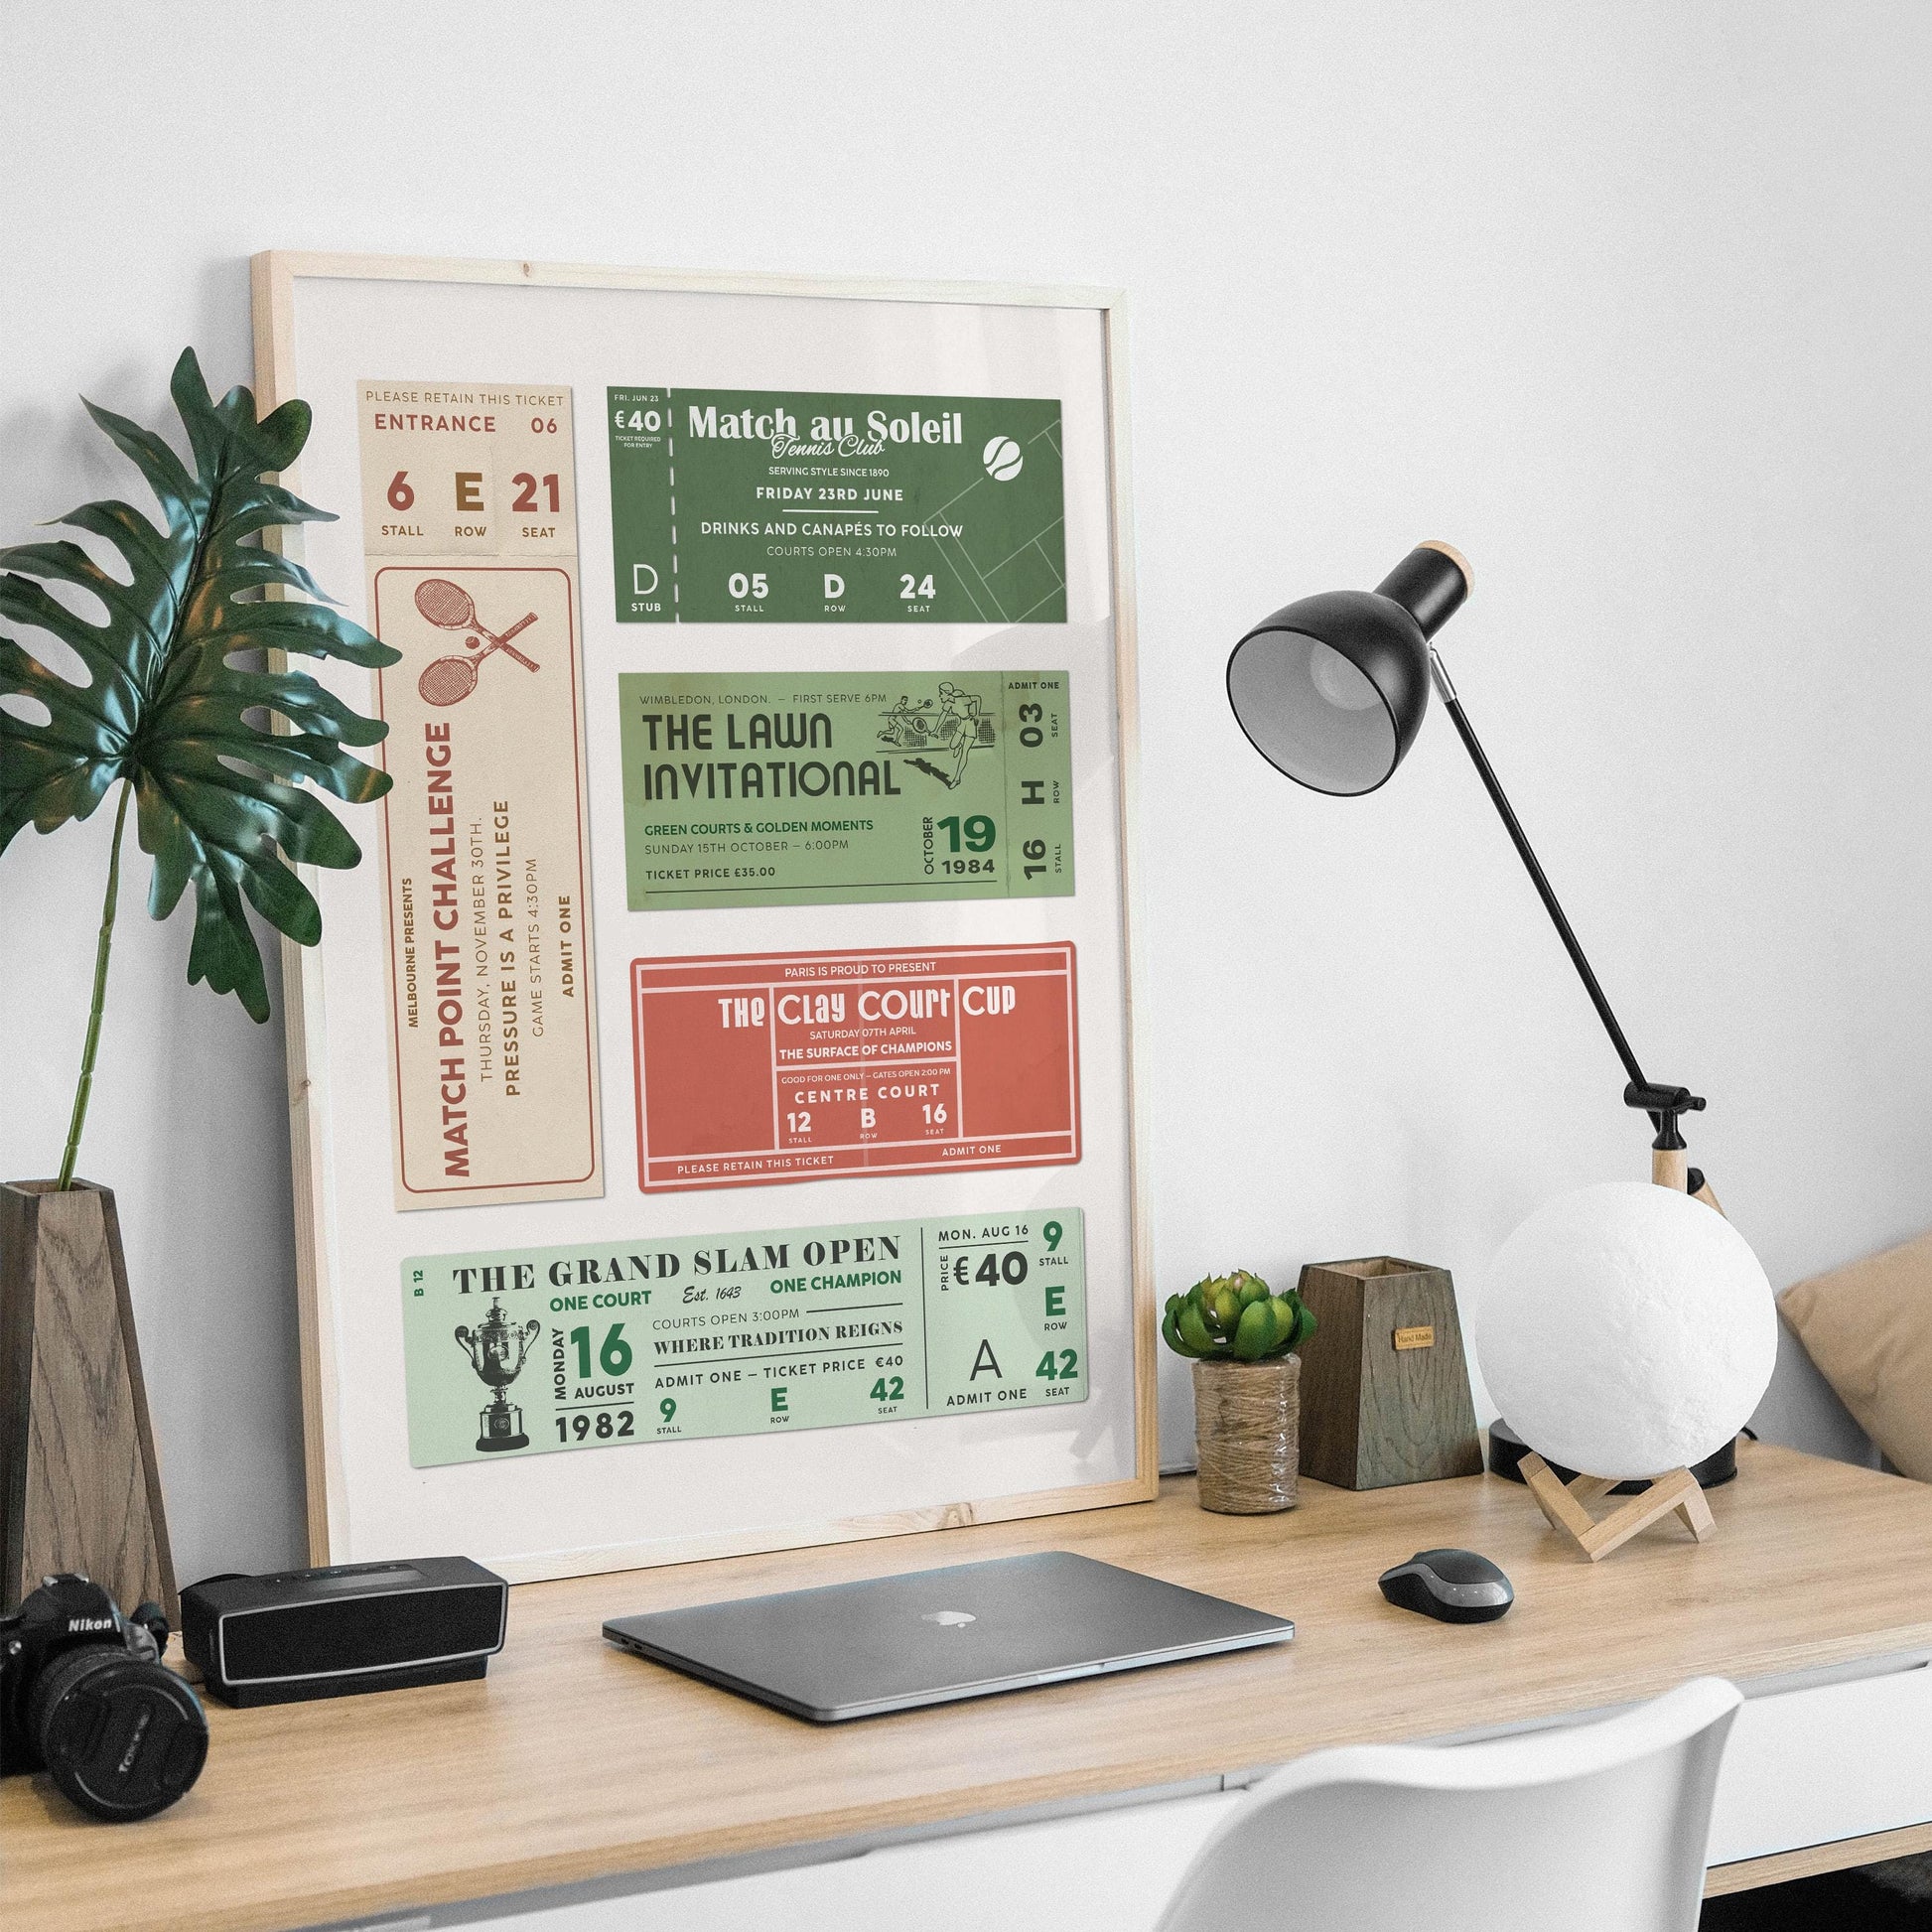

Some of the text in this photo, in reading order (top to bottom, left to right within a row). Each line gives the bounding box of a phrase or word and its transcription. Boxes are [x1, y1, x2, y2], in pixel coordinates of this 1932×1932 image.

[366, 390, 564, 406] PLEASE RETAIN THIS TICKET
[375, 413, 557, 434] ENTRANCE 06
[688, 405, 962, 444] Match au Soleil
[771, 432, 886, 460] Tennis Club
[768, 467, 890, 478] SERVING STYLE SINCE 1890
[387, 471, 415, 511] 6
[455, 472, 484, 511] E
[511, 473, 560, 512] 21
[757, 486, 903, 501] FRIDAY 23RD JUNE
[381, 525, 424, 536] STALL
[455, 526, 486, 537] ROW
[701, 521, 963, 538] DRINKS AND CANAPÉS TO FOLLOW
[766, 546, 897, 557] COURTS OPEN 4:30PM
[633, 564, 658, 595] D
[729, 573, 768, 599] 05
[824, 574, 845, 599] D
[899, 574, 936, 599] 24
[631, 603, 661, 612] STUB
[1008, 681, 1037, 690] ADMIT
[639, 694, 887, 705] WIMBLEDON, LONDON. FIRST SERVE 6PM
[642, 713, 832, 751] THE LAWN
[1019, 703, 1043, 748] 03
[643, 759, 901, 800] INVITATIONAL
[1021, 780, 1044, 804] H
[644, 820, 874, 836] GREEN COURTS GOLDEN MOMENTS
[936, 815, 996, 853] 19
[644, 840, 849, 855] SUNDAY 15TH OCTOBER 6:00PM
[922, 816, 934, 875] OCTOBER
[941, 859, 995, 875] 1984
[1023, 839, 1046, 881] 16
[645, 867, 775, 880] TICKET PRICE £35.00
[402, 878, 418, 1028] MELBOURNE PRESENTS
[425, 723, 470, 1177] MATCH POINT CHALLENGE
[470, 818, 492, 1082] THURSDAY, NOVEMBER 30TH.
[493, 801, 520, 1096] PRESSURE IS A PRIVILEGE
[525, 859, 544, 1037] GAME STARTS 4:30PM
[558, 896, 574, 998] ADMIT ONE
[785, 961, 936, 977] PARIS IS PROUD TO PRESENT
[810, 1027, 916, 1039] SATURDAY 07TH APRIL
[779, 1040, 952, 1059] THE SURFACE OF CHAMPIONS
[794, 1083, 939, 1104] CENTRE COURT
[787, 1111, 811, 1133] 12
[861, 1108, 876, 1128] B
[922, 1103, 947, 1124] 16
[942, 1145, 1001, 1157] ADMIT ONE
[677, 1156, 834, 1174] PLEASE RETAIN THIS TICKET
[938, 1224, 1029, 1242] MON. AUG 16
[1042, 1221, 1062, 1252] 9
[453, 1235, 899, 1294] THE GRAND SLAM OPEN
[940, 1255, 949, 1292] PRICE
[770, 1270, 901, 1294] ONE CHAMPION
[550, 1290, 652, 1311] ONE COURT
[682, 1286, 742, 1304] Est. 1643
[1045, 1286, 1066, 1316] E
[652, 1309, 799, 1330] COURTS OPEN 3:00PM
[570, 1322, 632, 1379] 16
[653, 1321, 902, 1355] WHERE TRADITION REIGNS
[552, 1328, 566, 1400] MONDAY
[970, 1339, 1003, 1381] A
[1035, 1348, 1078, 1381] 42
[655, 1374, 703, 1389] ADMIT
[710, 1370, 742, 1383] ONE
[763, 1363, 816, 1378] TICKET
[823, 1358, 865, 1373] PRICE
[574, 1382, 634, 1399] AUGUST
[771, 1387, 788, 1412] E
[870, 1376, 904, 1402] 42
[946, 1388, 1027, 1407] ADMIT ONE
[659, 1398, 677, 1423] 9
[555, 1410, 634, 1443] 1982
[69, 1618, 112, 1631] Nikon
